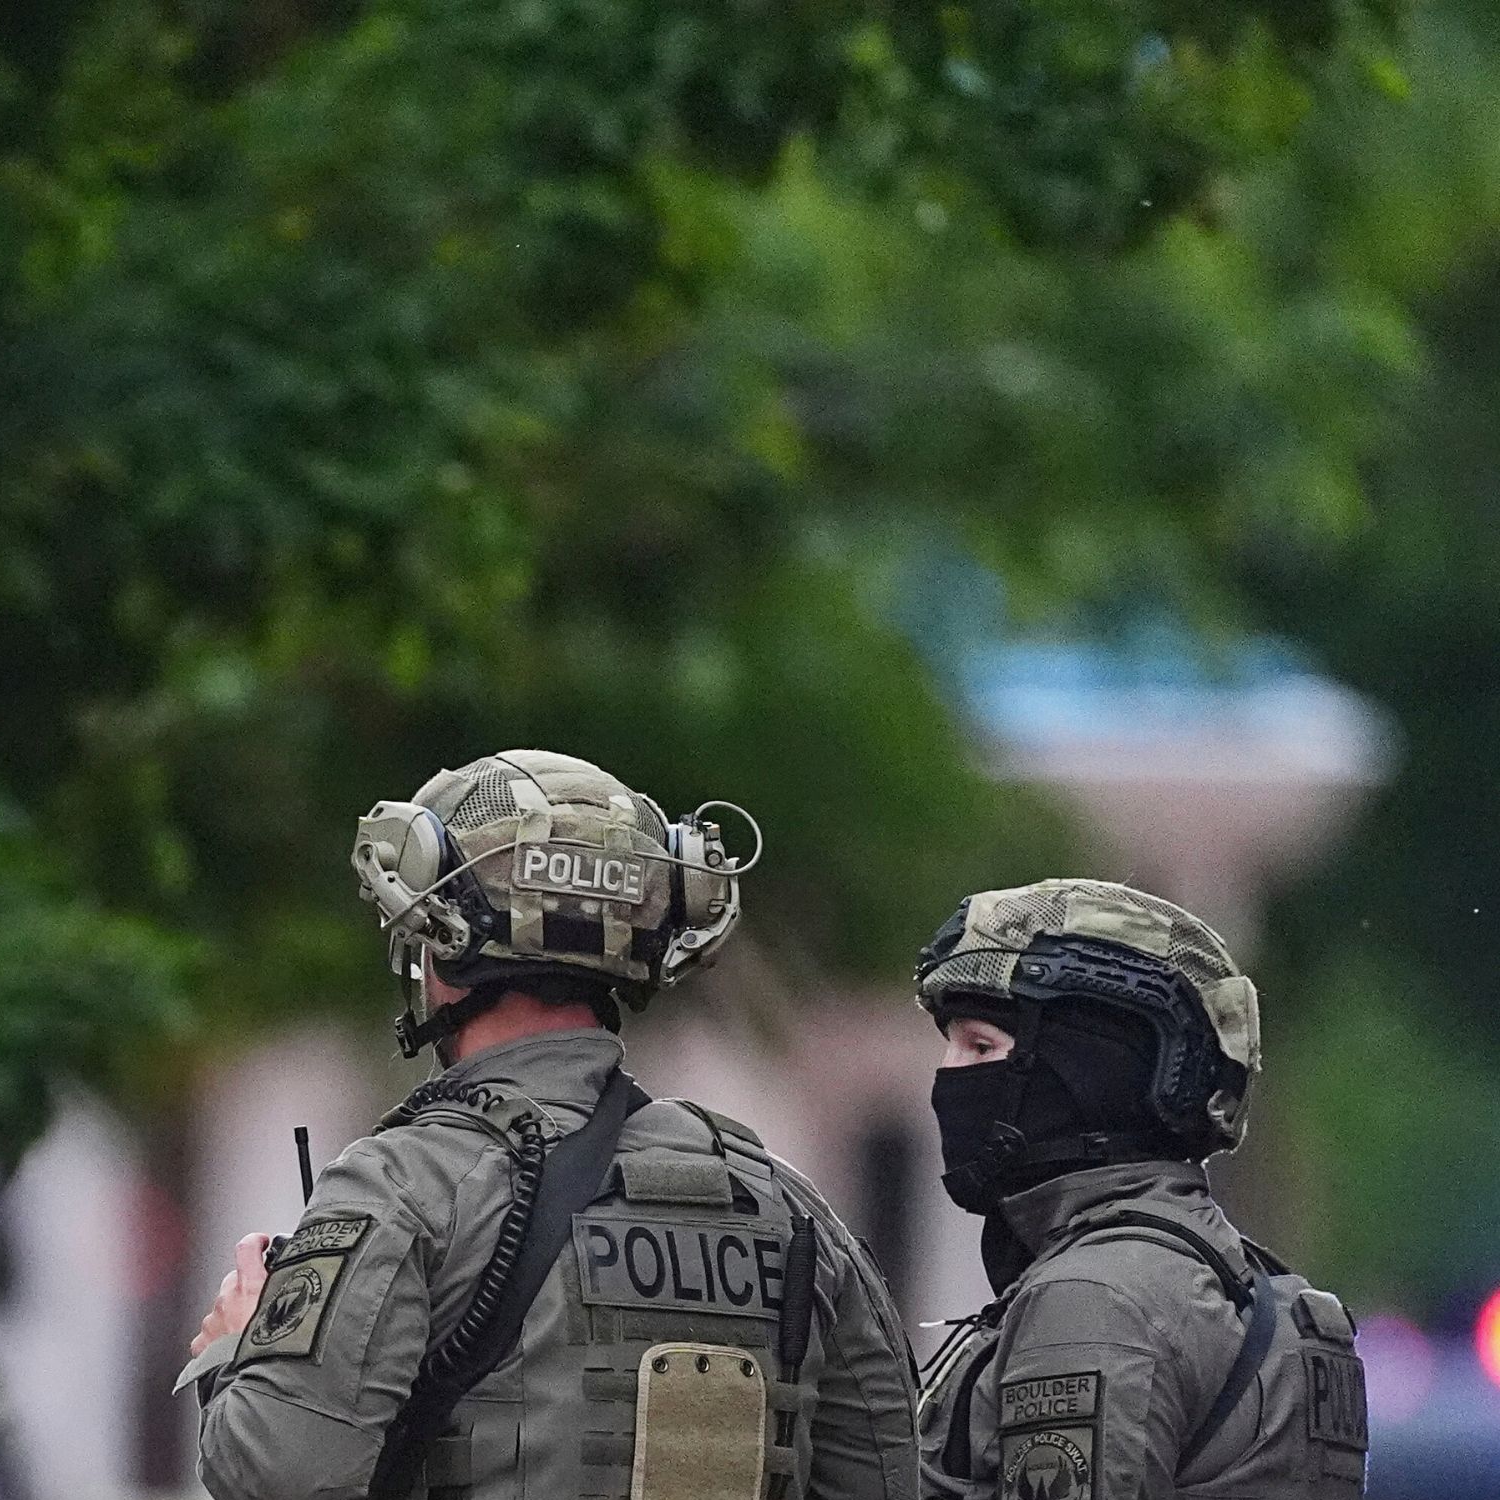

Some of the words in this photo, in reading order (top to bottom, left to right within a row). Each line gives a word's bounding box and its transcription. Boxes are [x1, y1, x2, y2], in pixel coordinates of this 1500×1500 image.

[524, 849, 640, 895] POLICE
[585, 1224, 783, 1309] POLICE
[1005, 1378, 1090, 1404] BOULDER
[1014, 1397, 1078, 1420] POLICE
